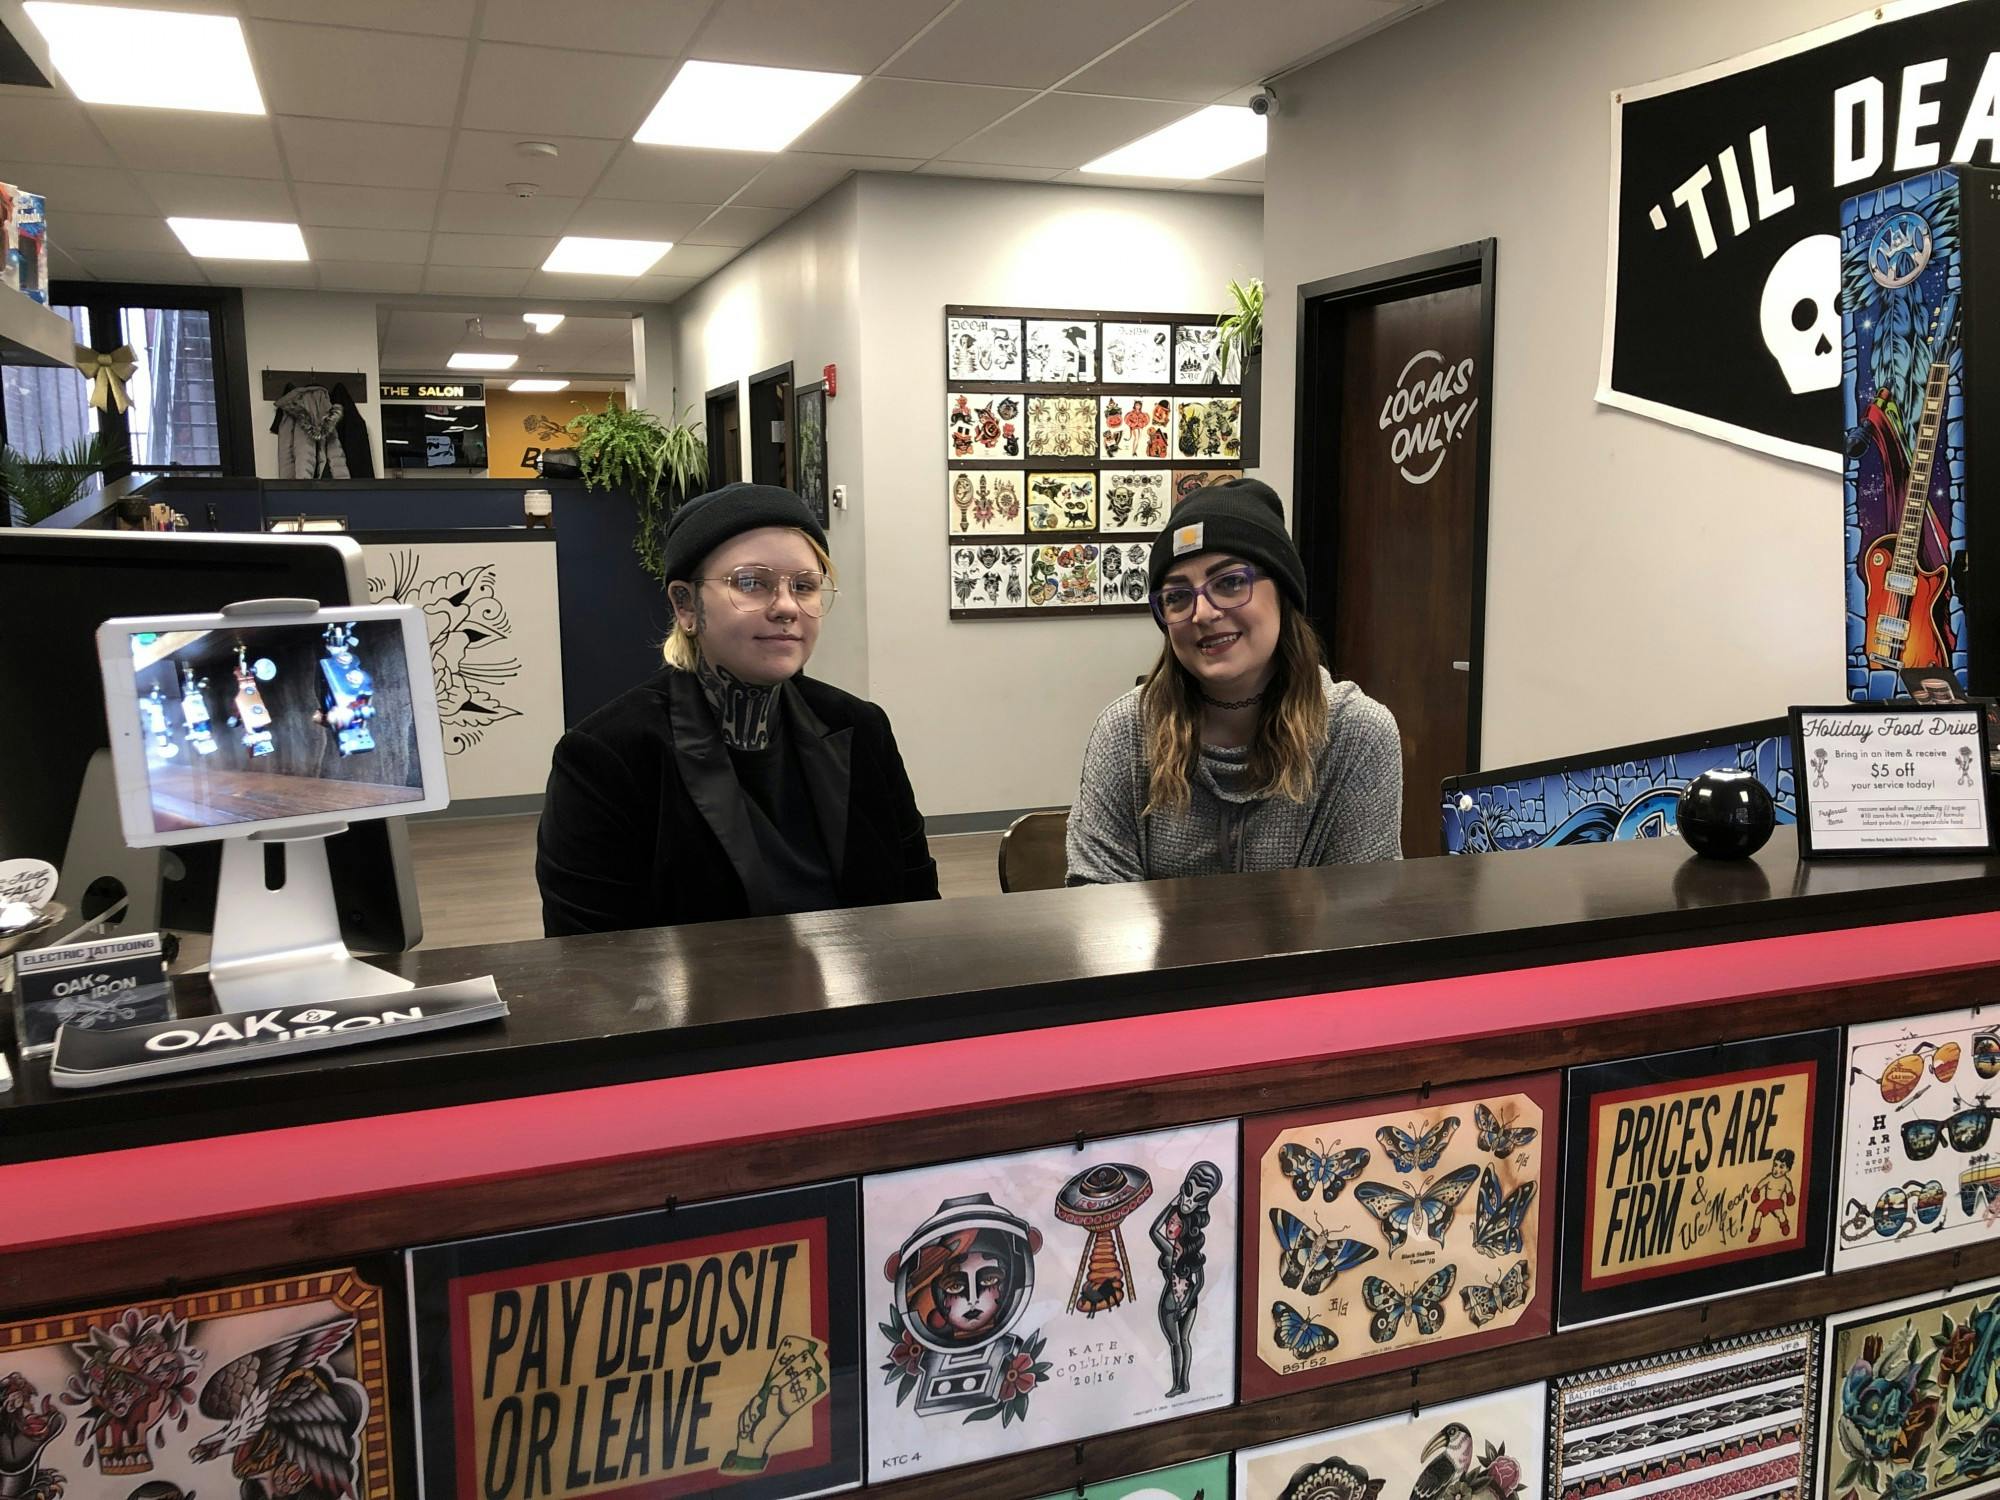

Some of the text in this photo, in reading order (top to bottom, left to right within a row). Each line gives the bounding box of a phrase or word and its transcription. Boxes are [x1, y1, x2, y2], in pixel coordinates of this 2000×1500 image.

[1649, 124, 1795, 259] 'TIL
[381, 386, 464, 397] THE SALON
[1379, 358, 1474, 430] LOCALS
[1391, 397, 1478, 464] ONLY!
[1802, 717, 1980, 743] Holiday Food Drive
[1835, 750, 1858, 760] Bring
[1861, 750, 1868, 758] in
[1885, 749, 1903, 758] item
[1906, 749, 1913, 758] &
[1915, 749, 1947, 758] receive
[1871, 762, 1916, 778] $5 off
[1851, 780, 1935, 791] your service today!
[23, 939, 154, 965] ELECTRIC TATTOOING
[53, 973, 94, 996] OAK
[92, 976, 137, 999] IRON
[145, 1009, 286, 1051] OAK
[1606, 1095, 1720, 1189] PRICES
[1717, 1084, 1786, 1168] ARE
[1601, 1175, 1708, 1266] FIRM &
[1678, 1184, 1752, 1250] We Mean
[483, 1244, 798, 1400] PAY DEPOSIT
[1068, 1341, 1119, 1357] KATE
[484, 1361, 722, 1500] OR LEAVE
